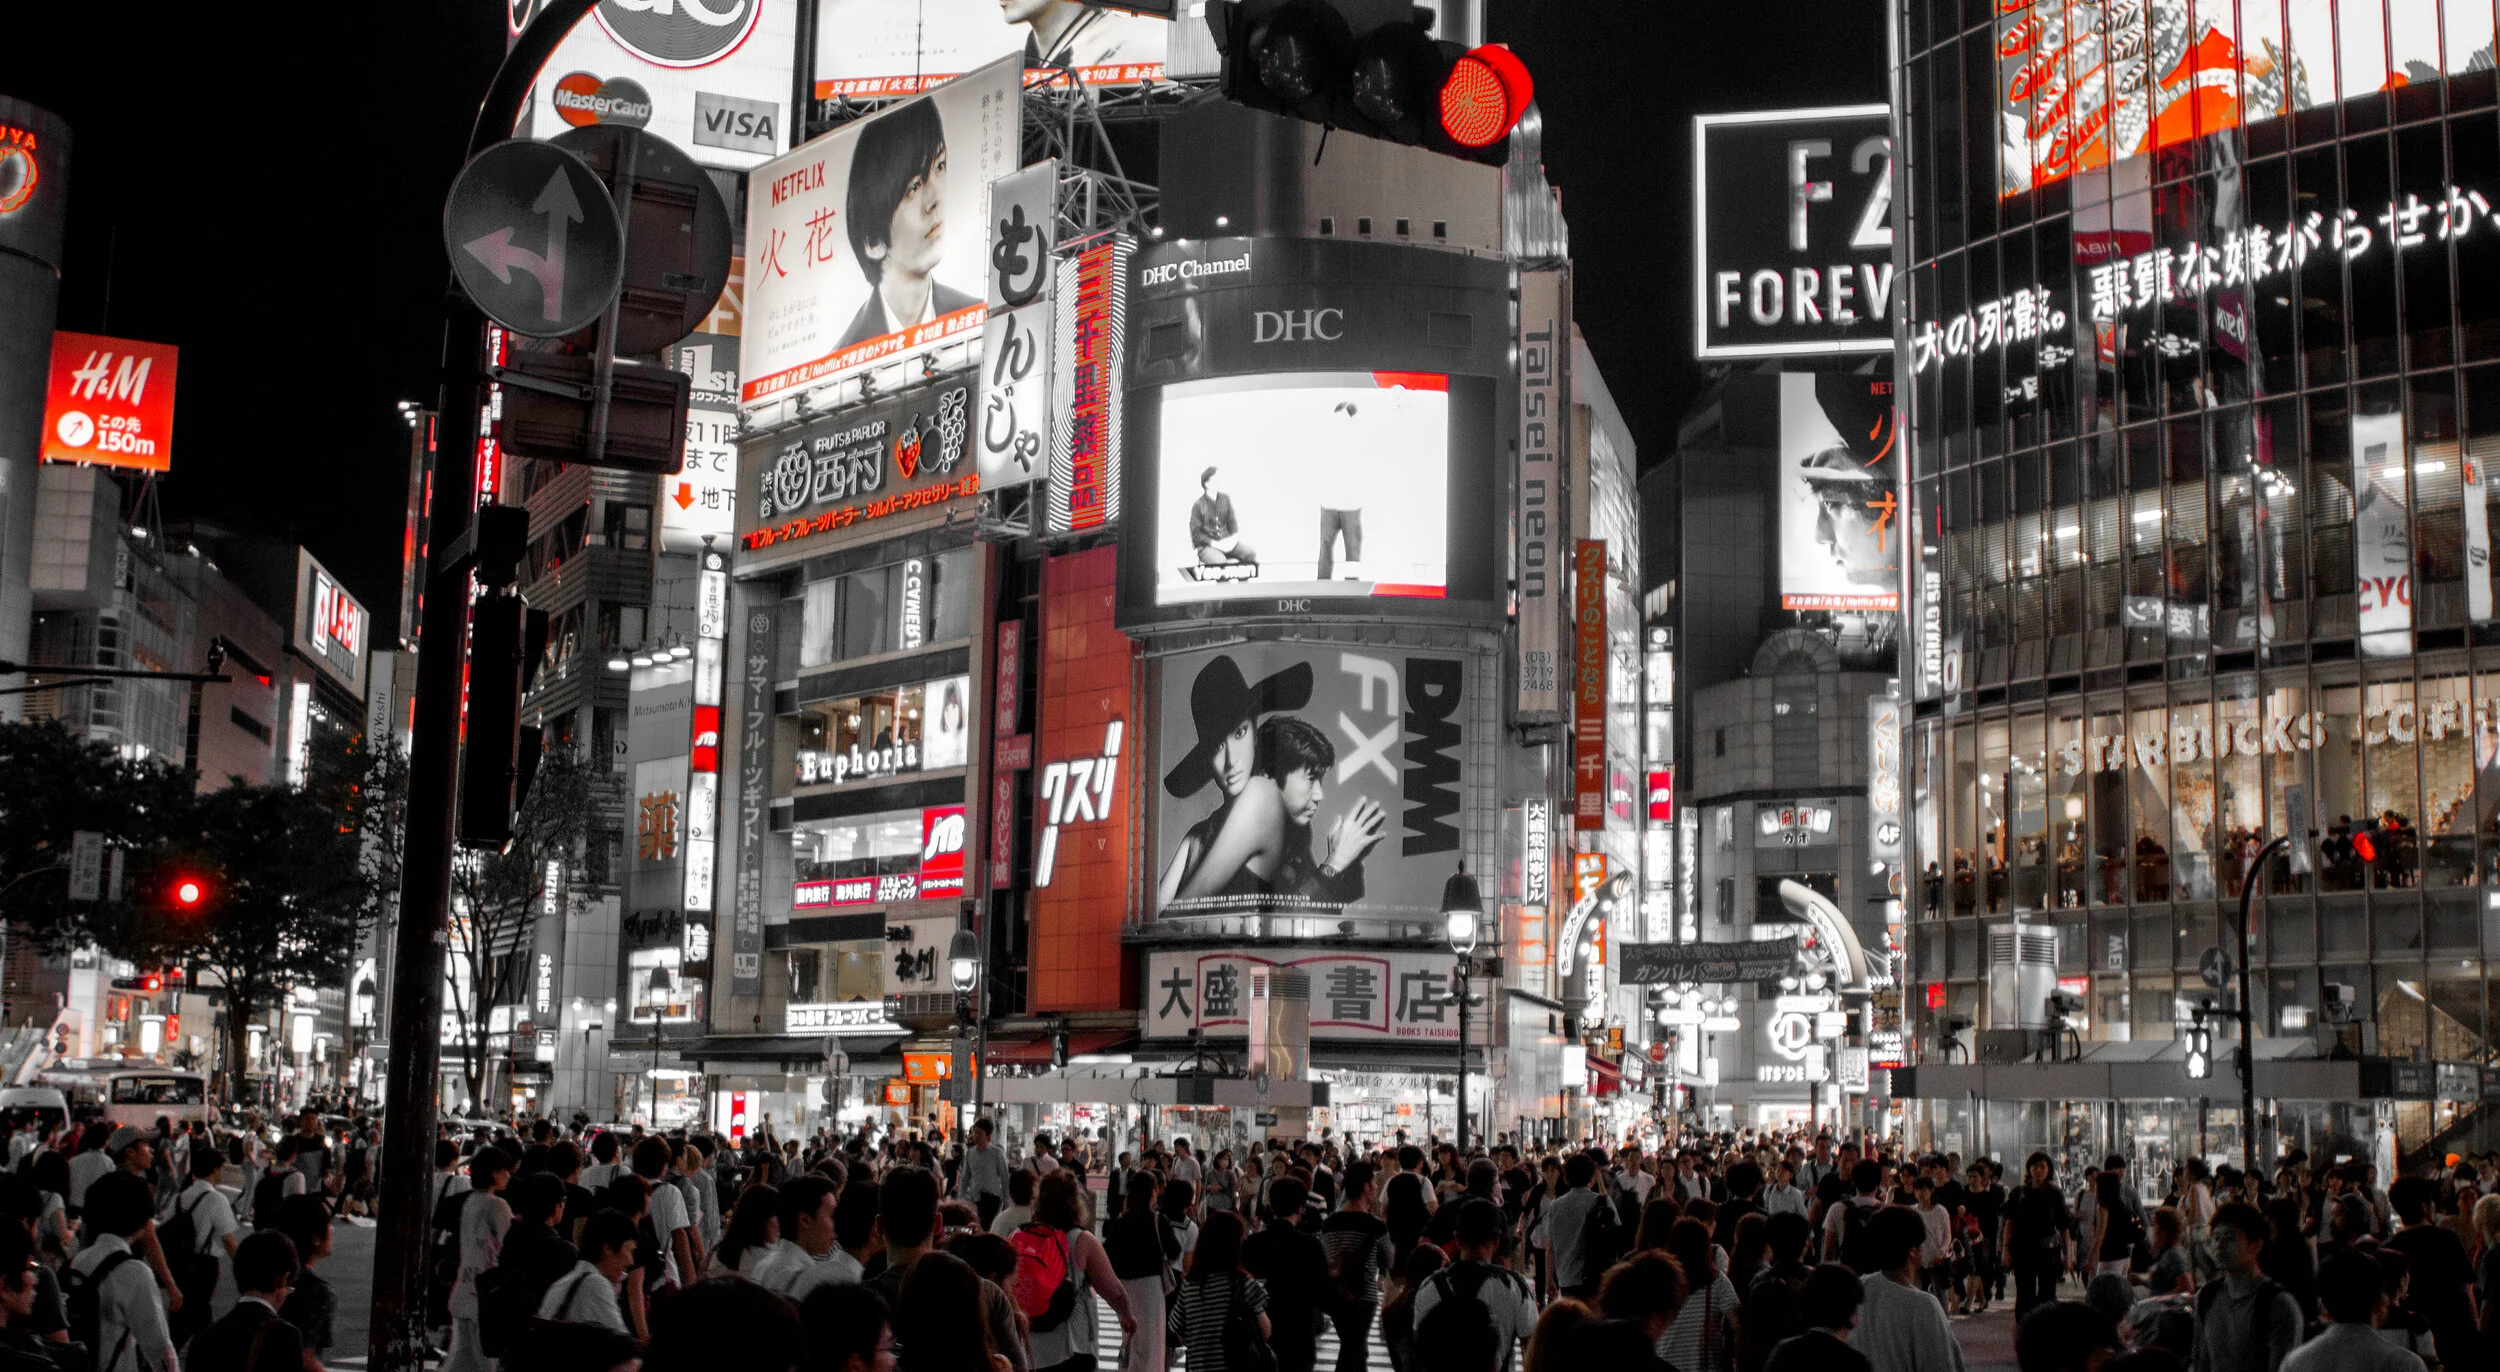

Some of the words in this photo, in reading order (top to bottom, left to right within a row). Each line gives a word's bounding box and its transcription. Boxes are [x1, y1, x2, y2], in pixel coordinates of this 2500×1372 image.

[555, 88, 651, 120] MasterCard
[704, 108, 775, 141] VISA
[771, 160, 826, 209] NETFLIX
[757, 206, 836, 291] 火花
[1142, 263, 1178, 287] DHC
[1179, 253, 1251, 279] Channel
[984, 203, 1048, 473] もんじゃ
[1253, 307, 1344, 344] DHC
[71, 350, 152, 407] H&M
[1524, 318, 1554, 462] Taisei
[97, 431, 155, 457] 150m
[98, 414, 142, 433] この先
[686, 448, 729, 472] まで
[814, 440, 885, 503] 西村
[760, 472, 774, 518] 渋谷
[1524, 478, 1548, 599] neon
[329, 585, 362, 657] LABI
[1278, 599, 1311, 613] DHC
[1580, 546, 1602, 704] クスリのことなら
[1523, 666, 1554, 680] 3719
[1525, 651, 1552, 664] (03)
[1523, 680, 1554, 691] 2468
[633, 702, 677, 718] Matsumoto
[1337, 652, 1399, 786] FX
[743, 655, 769, 847] サマーフルーツギフト
[800, 738, 918, 785] Euphoria
[1402, 657, 1463, 858] DMM
[1578, 717, 1603, 816] 三千里
[2063, 711, 2328, 776] STARBUCKS
[1034, 719, 1125, 889] クスリ
[923, 814, 966, 861] JTB
[835, 881, 872, 901] 海外旅行
[880, 876, 915, 890] ハネムーン
[1158, 963, 1450, 1025] 大盛書店
[1633, 964, 1698, 982] ガンバレ!
[1396, 1027, 1422, 1038] BOOKS
